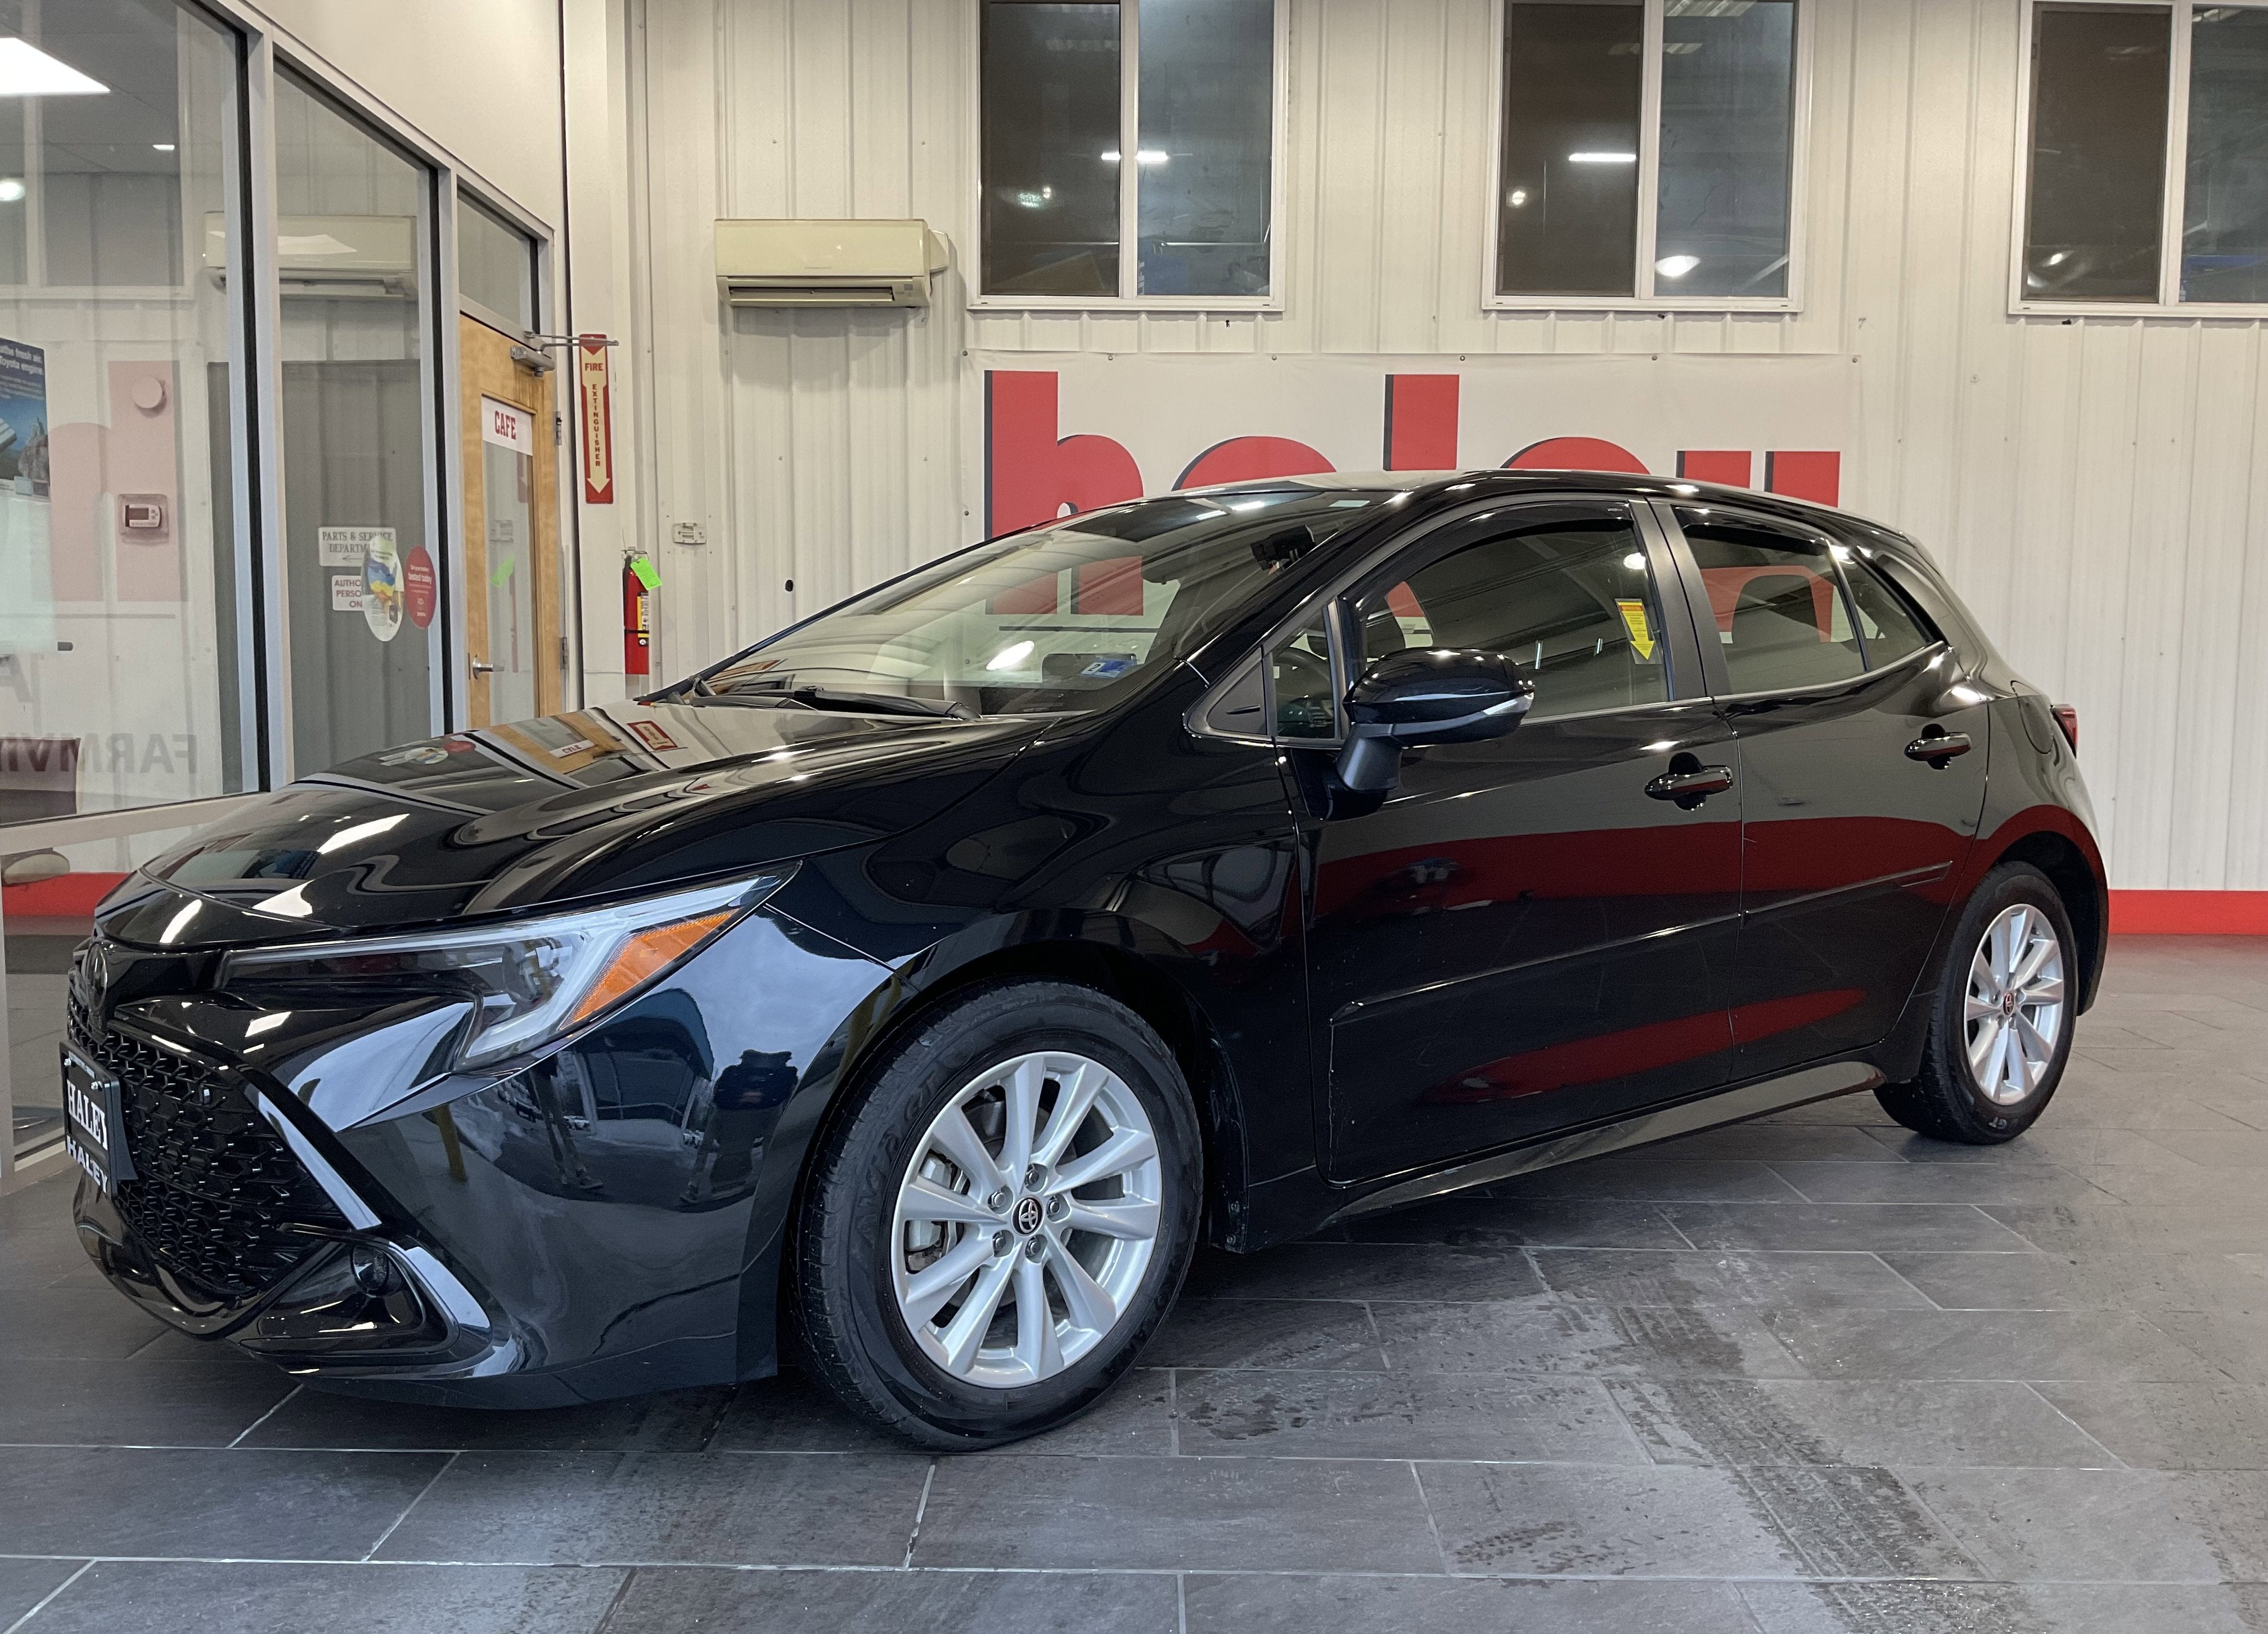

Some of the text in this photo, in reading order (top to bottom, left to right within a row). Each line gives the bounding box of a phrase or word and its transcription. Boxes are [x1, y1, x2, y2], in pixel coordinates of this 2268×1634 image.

[495, 411, 516, 440] CAFE
[592, 384, 601, 466] EXTINGUISHER
[322, 532, 347, 541] PARTS
[350, 532, 356, 541] &
[66, 1079, 108, 1151] HALEY
[66, 1135, 108, 1193] HALEY
